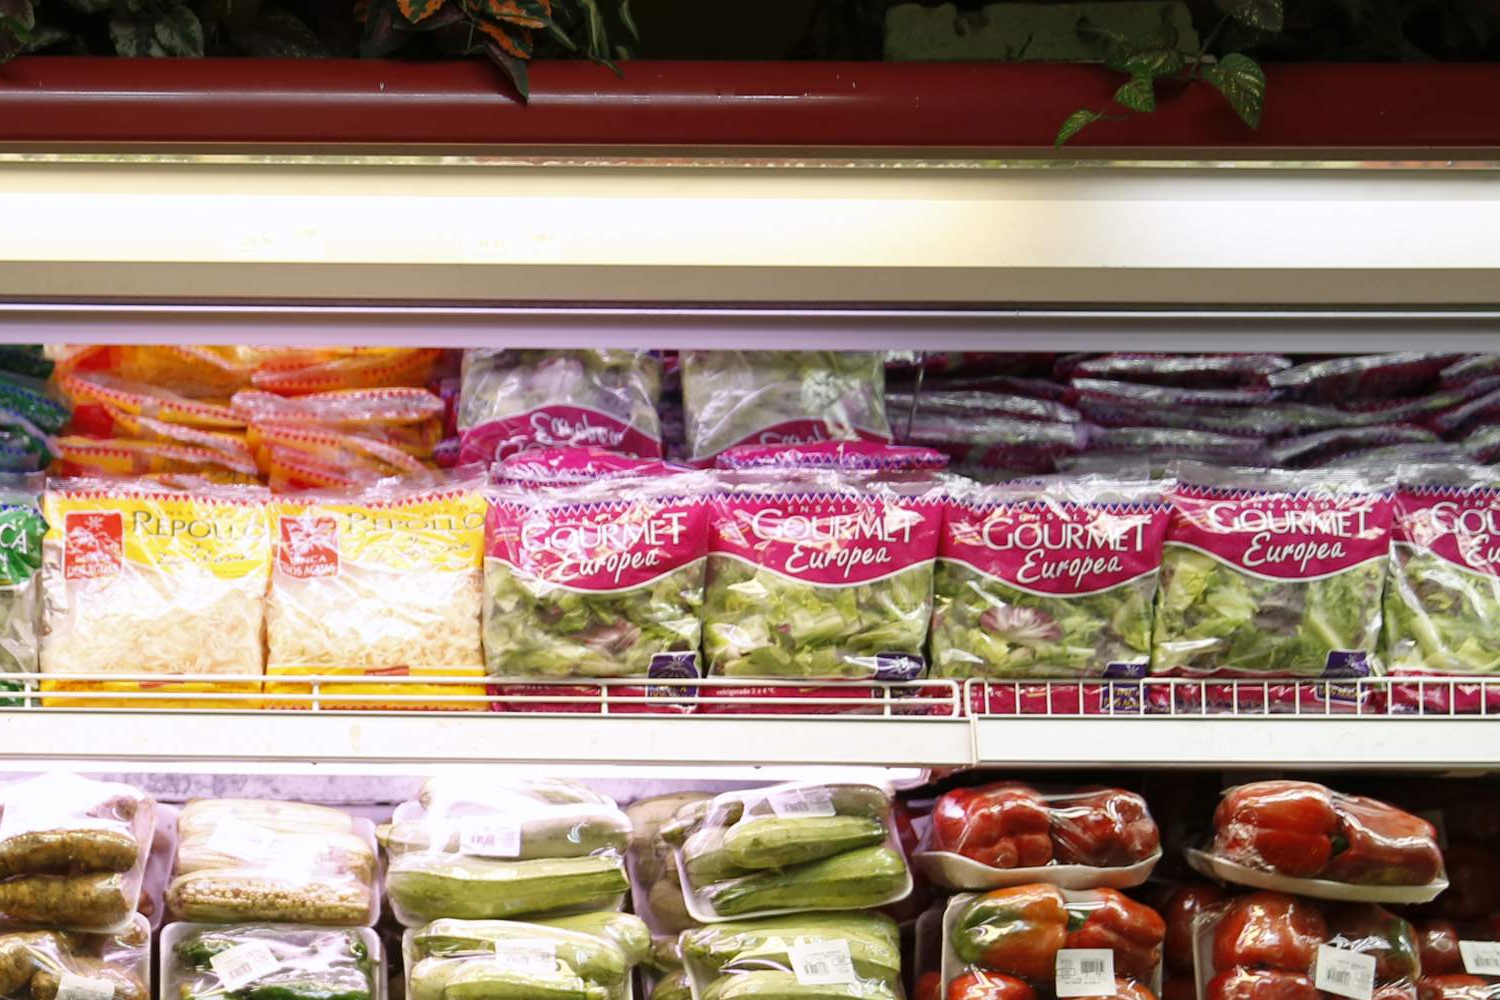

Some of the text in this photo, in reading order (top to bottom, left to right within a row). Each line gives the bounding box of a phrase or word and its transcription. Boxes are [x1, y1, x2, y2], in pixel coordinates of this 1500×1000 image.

[521, 511, 688, 551] GOURMET
[752, 508, 915, 543] GOURMET
[982, 514, 1153, 552] GOURMET
[1210, 502, 1374, 539] GOURMET
[555, 546, 661, 585] Europea
[785, 540, 892, 579] Europea
[1016, 549, 1124, 589] Europea
[1242, 531, 1347, 573] Europea
